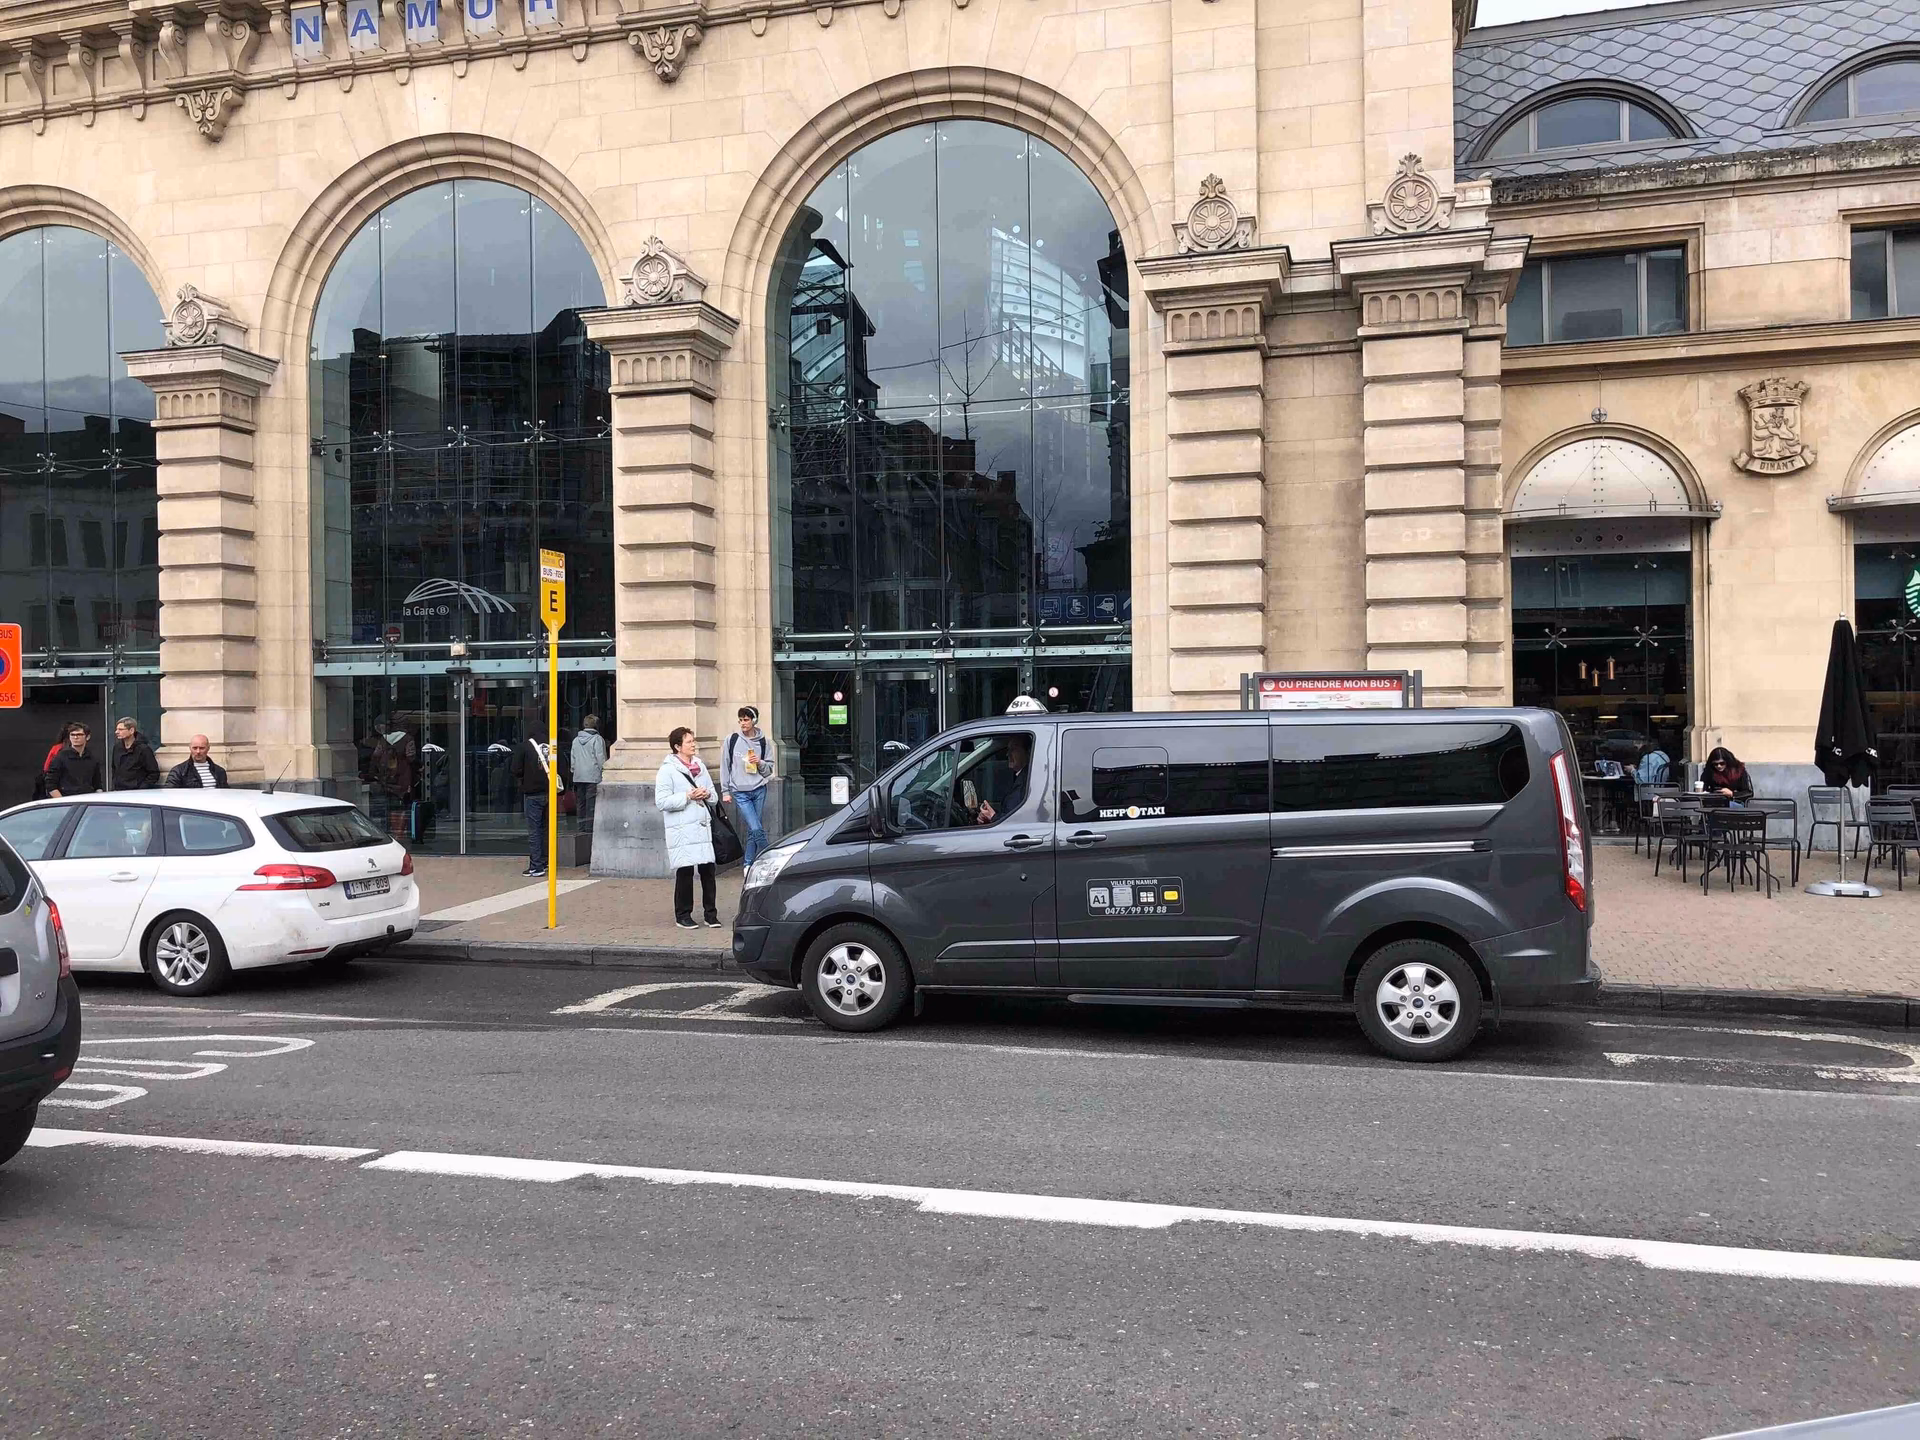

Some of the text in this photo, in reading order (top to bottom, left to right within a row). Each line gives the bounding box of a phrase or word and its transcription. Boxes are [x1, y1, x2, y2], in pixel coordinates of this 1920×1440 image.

[550, 590, 558, 612] E
[402, 606, 411, 616] la
[413, 606, 435, 616] Gare
[1296, 679, 1341, 689] PRENDRE
[1343, 679, 1369, 688] MON
[1370, 679, 1390, 688] BUS
[1140, 806, 1166, 816] TAXI
[1092, 894, 1107, 905] A1
[1143, 906, 1155, 914] 99
[1156, 905, 1167, 914] 88
